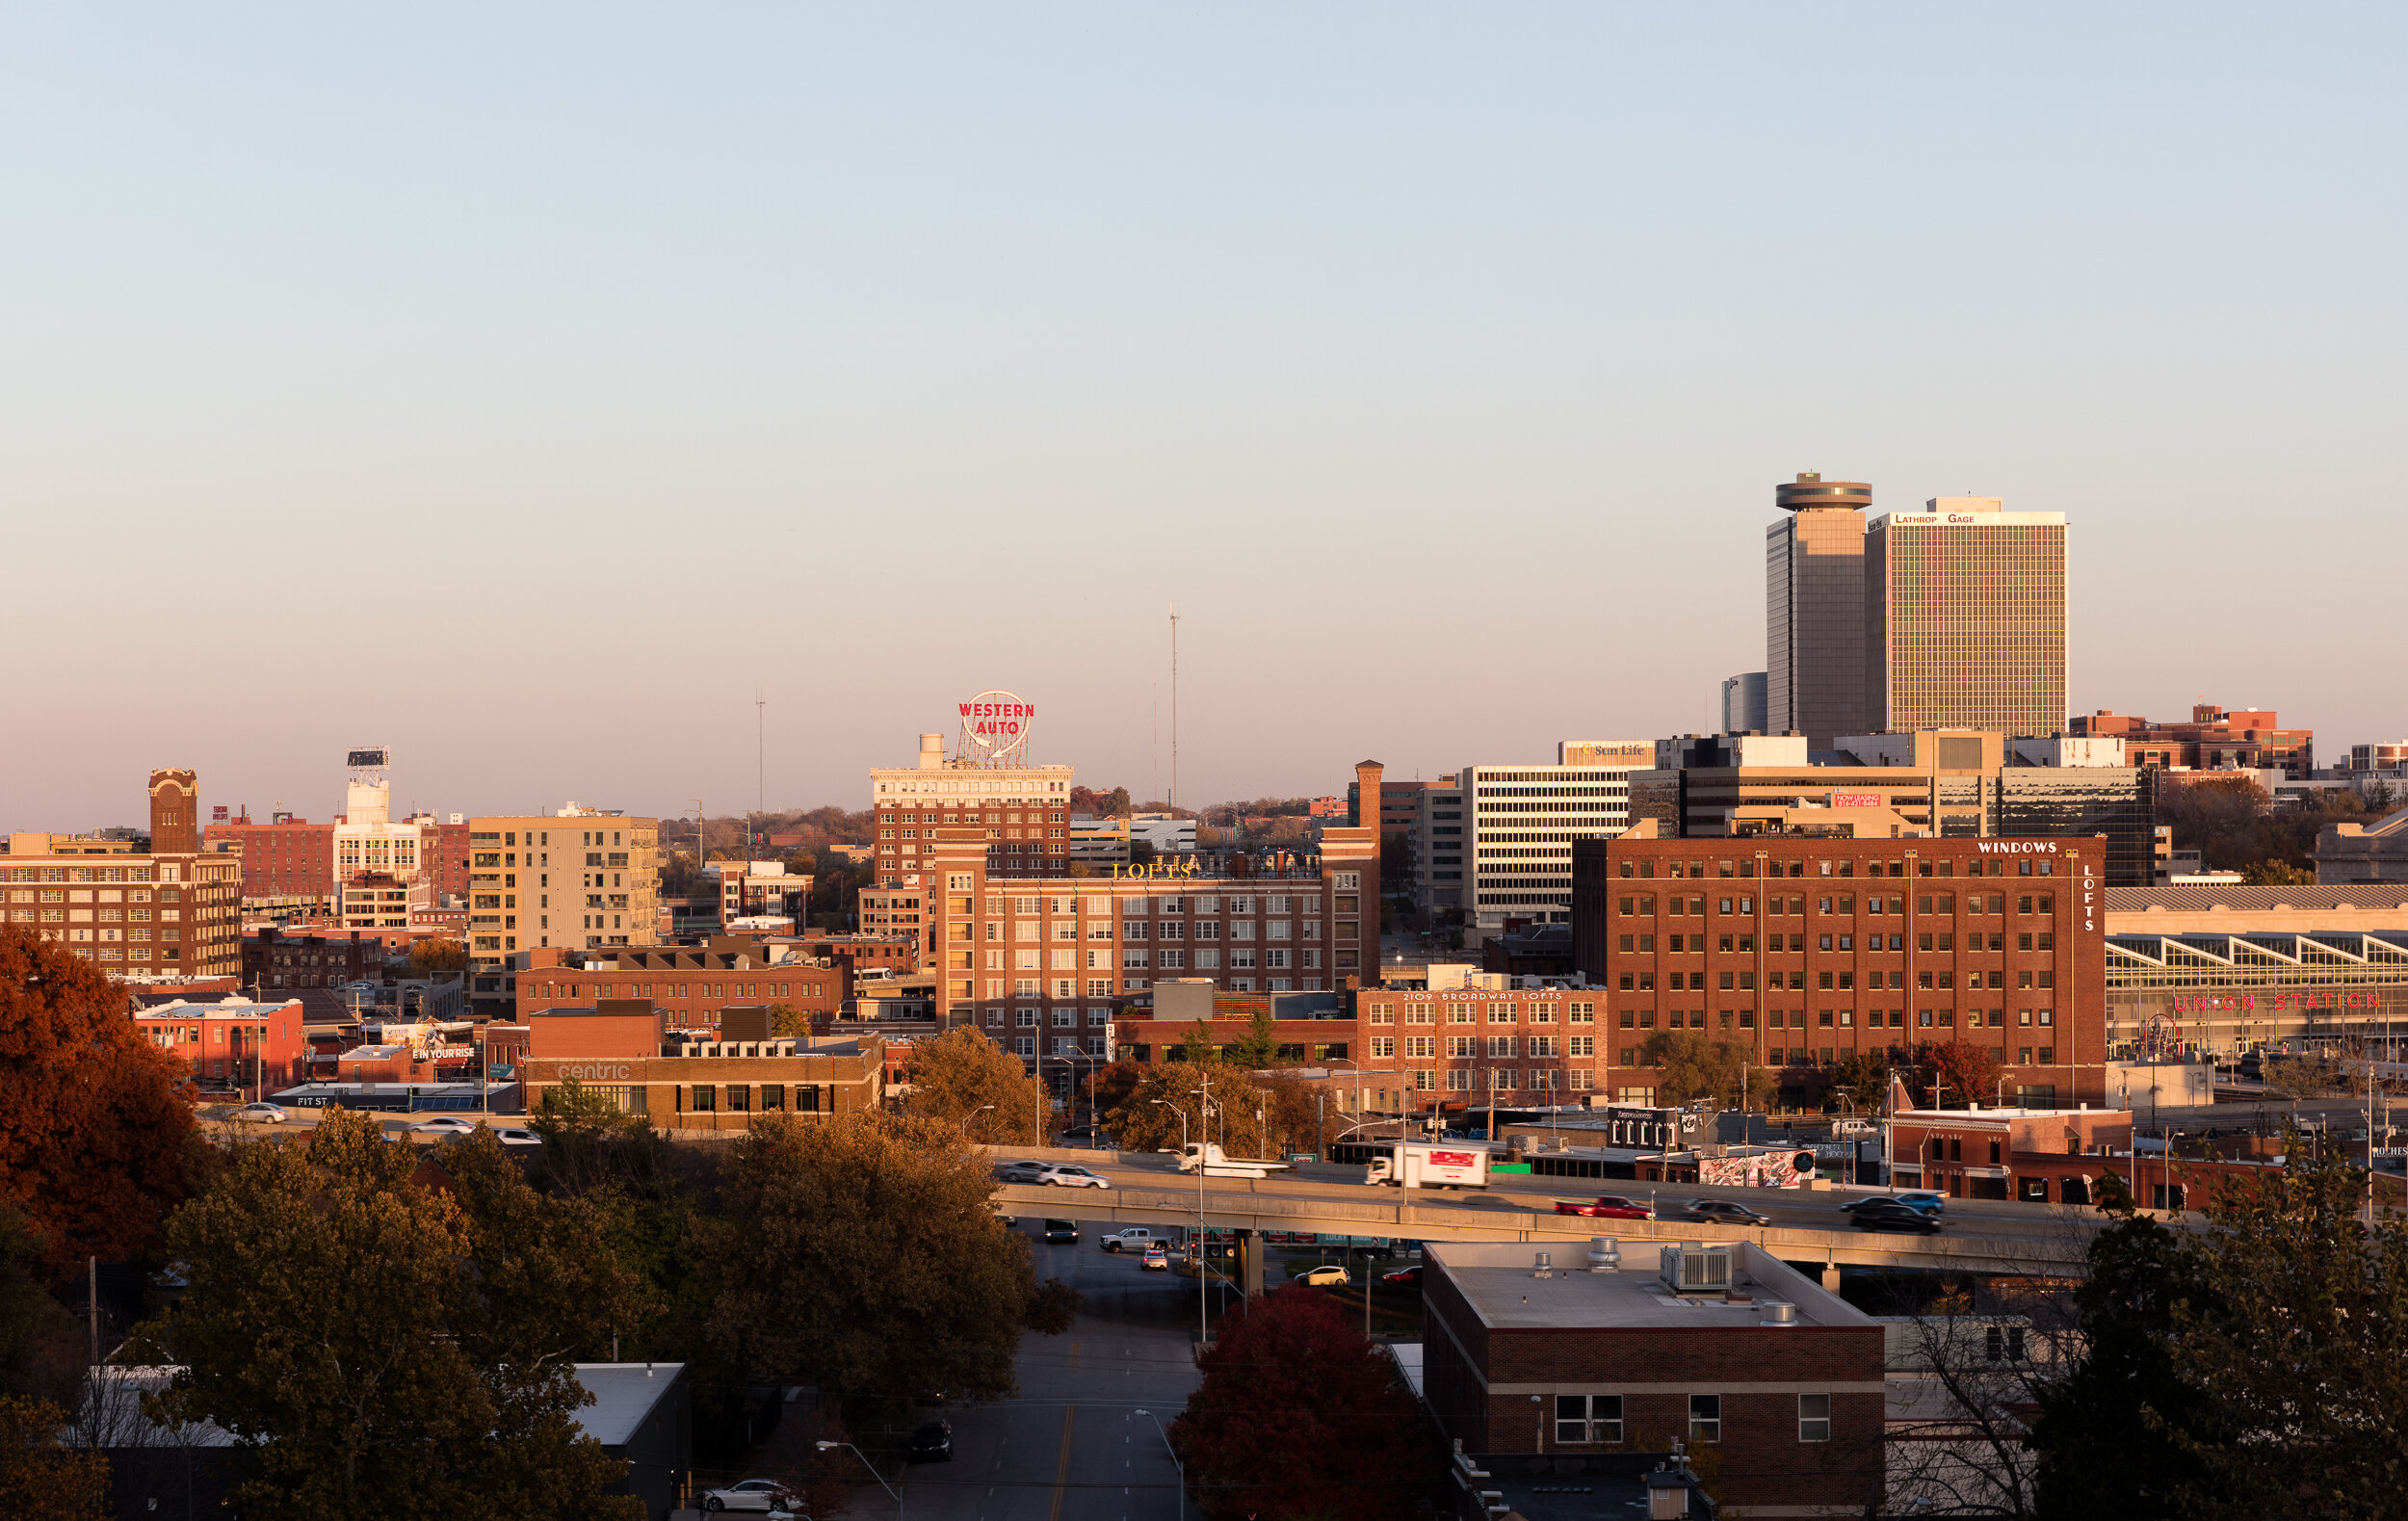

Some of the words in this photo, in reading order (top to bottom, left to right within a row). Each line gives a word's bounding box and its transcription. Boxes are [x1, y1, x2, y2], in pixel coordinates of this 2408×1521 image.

[1895, 513, 1937, 524] LATHROP
[1948, 513, 1975, 524] GAGE
[959, 703, 1034, 717] WESTERN
[976, 721, 1019, 735] AUTO
[1594, 746, 1624, 756] Sun
[1626, 746, 1644, 756] Life
[1977, 842, 2056, 853] WINDOWS
[1112, 863, 1191, 880] LOFTS
[2083, 865, 2094, 931] LOFTS
[2174, 995, 2255, 1012] UNION
[2274, 993, 2380, 1010] STATION
[419, 1049, 430, 1059] IN
[430, 1048, 455, 1059] YOUR
[456, 1047, 475, 1058] RISE
[557, 1062, 630, 1080] centric
[298, 1097, 313, 1106] FIT
